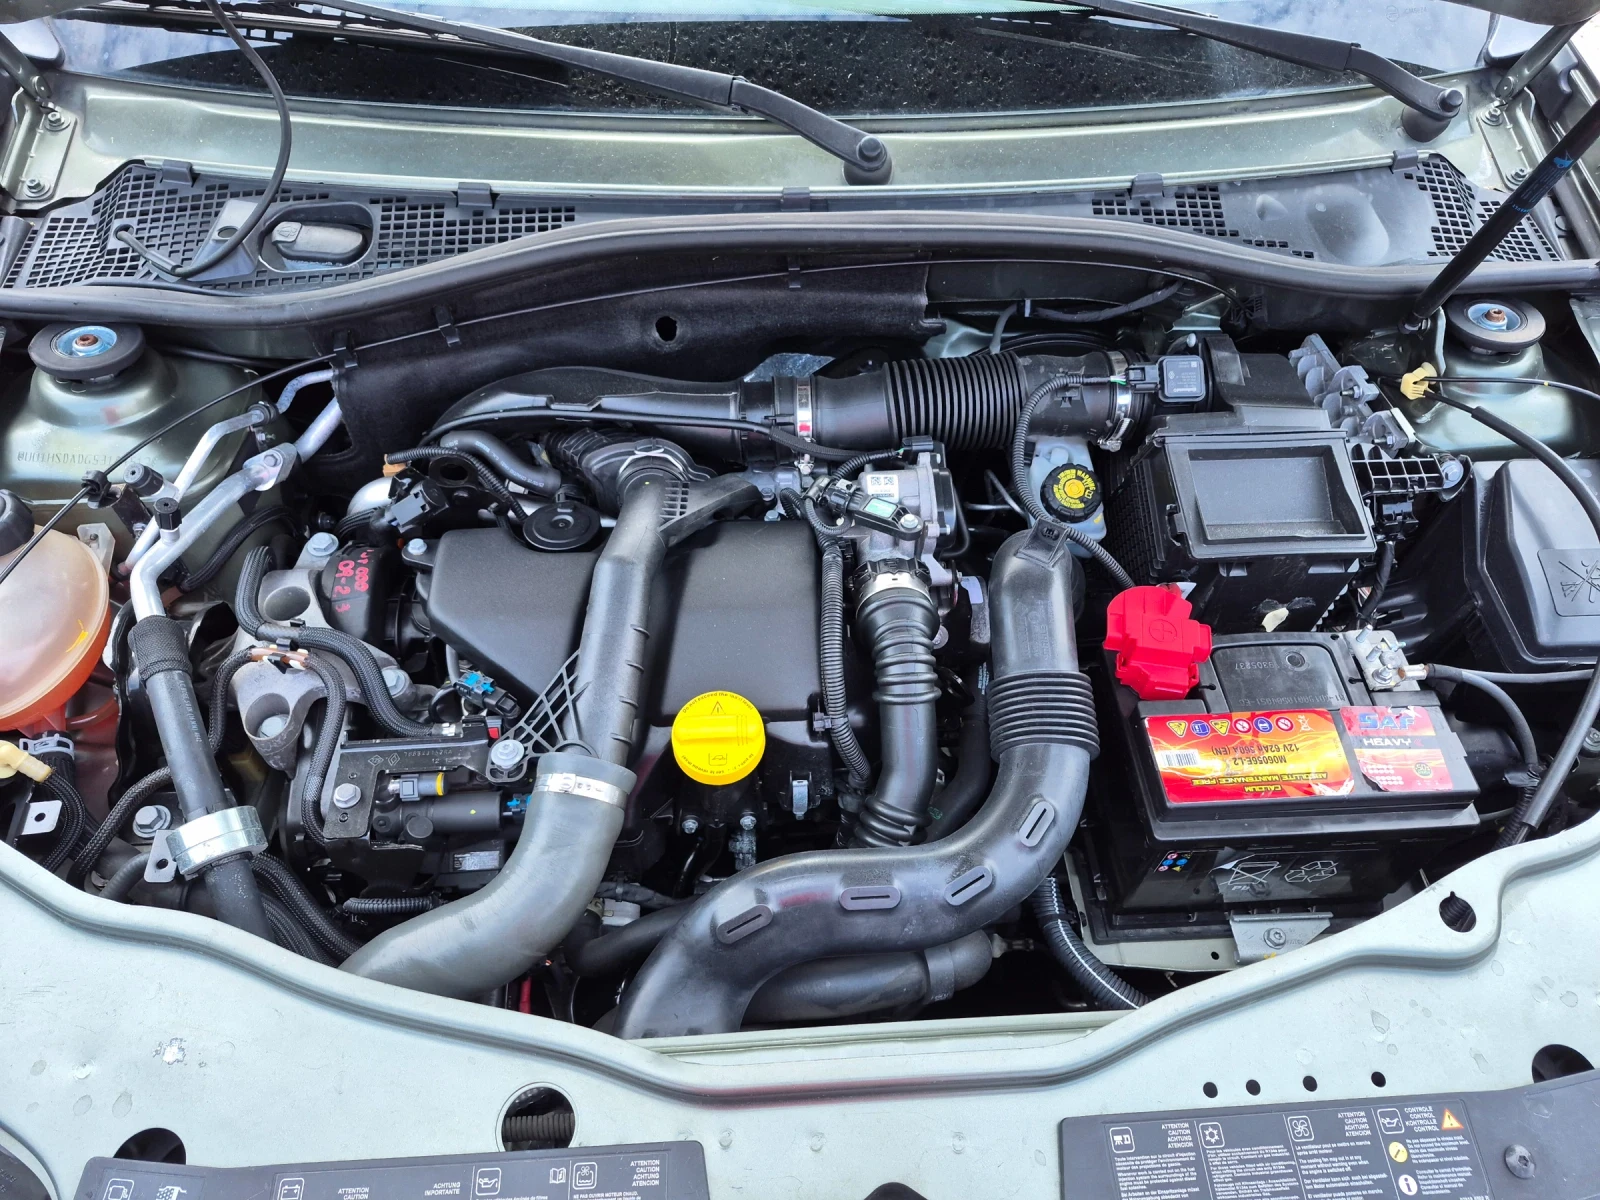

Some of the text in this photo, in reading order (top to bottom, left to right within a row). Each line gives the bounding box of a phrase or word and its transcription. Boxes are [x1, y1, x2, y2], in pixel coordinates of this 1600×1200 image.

[689, 699, 698, 707] not
[697, 692, 718, 702] exceed
[743, 700, 754, 710] level
[1358, 712, 1416, 731] SAF
[1363, 738, 1412, 746] HEAVY
[1211, 746, 1231, 756] (EN)
[1257, 744, 1280, 754] 62Ah
[1283, 743, 1299, 754] 12V
[1191, 772, 1328, 786] ABSOLUTE MAINTENANCE FREE
[1244, 784, 1282, 793] CALCIUM
[433, 1181, 461, 1189] ACHTUNG
[424, 1188, 460, 1196] IMPORTANTE
